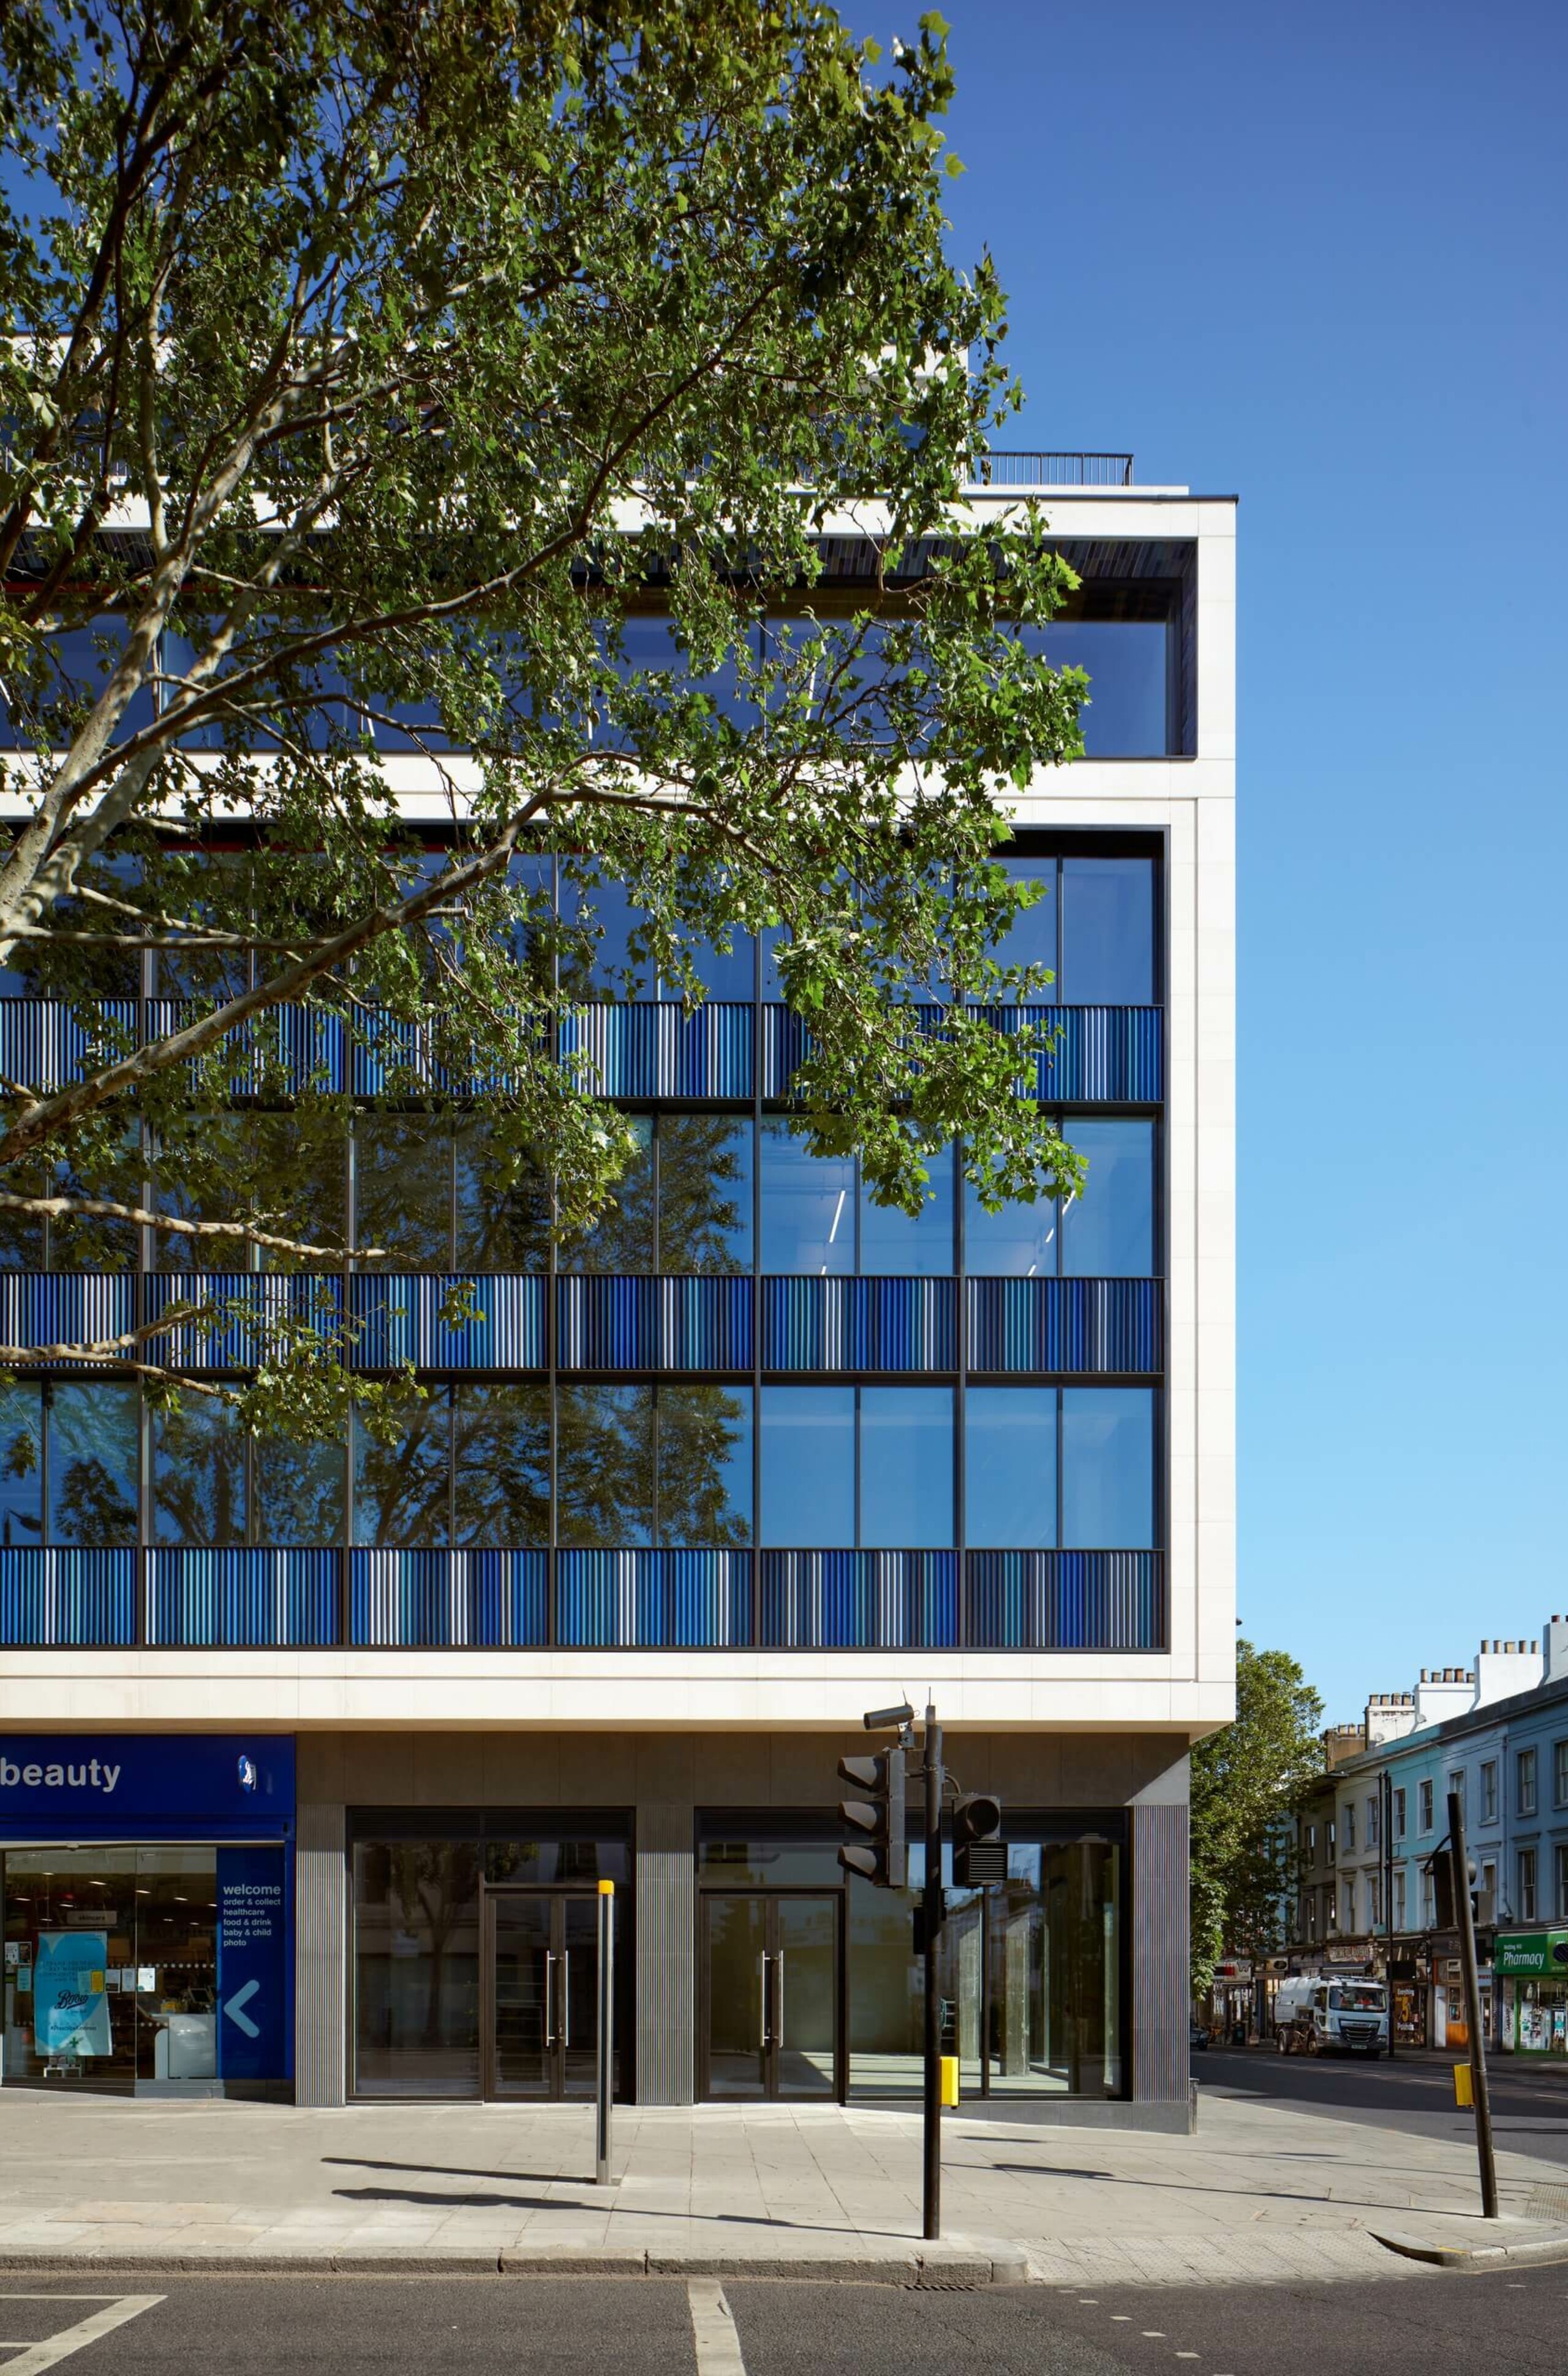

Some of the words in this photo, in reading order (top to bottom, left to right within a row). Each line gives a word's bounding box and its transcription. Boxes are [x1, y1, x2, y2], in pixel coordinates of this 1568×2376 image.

[0, 1757, 120, 1792] beauty
[223, 1884, 281, 1895] welcome
[223, 1928, 243, 1937] baby
[223, 1939, 247, 1947] photo
[1503, 1952, 1545, 1969] Pharmacy
